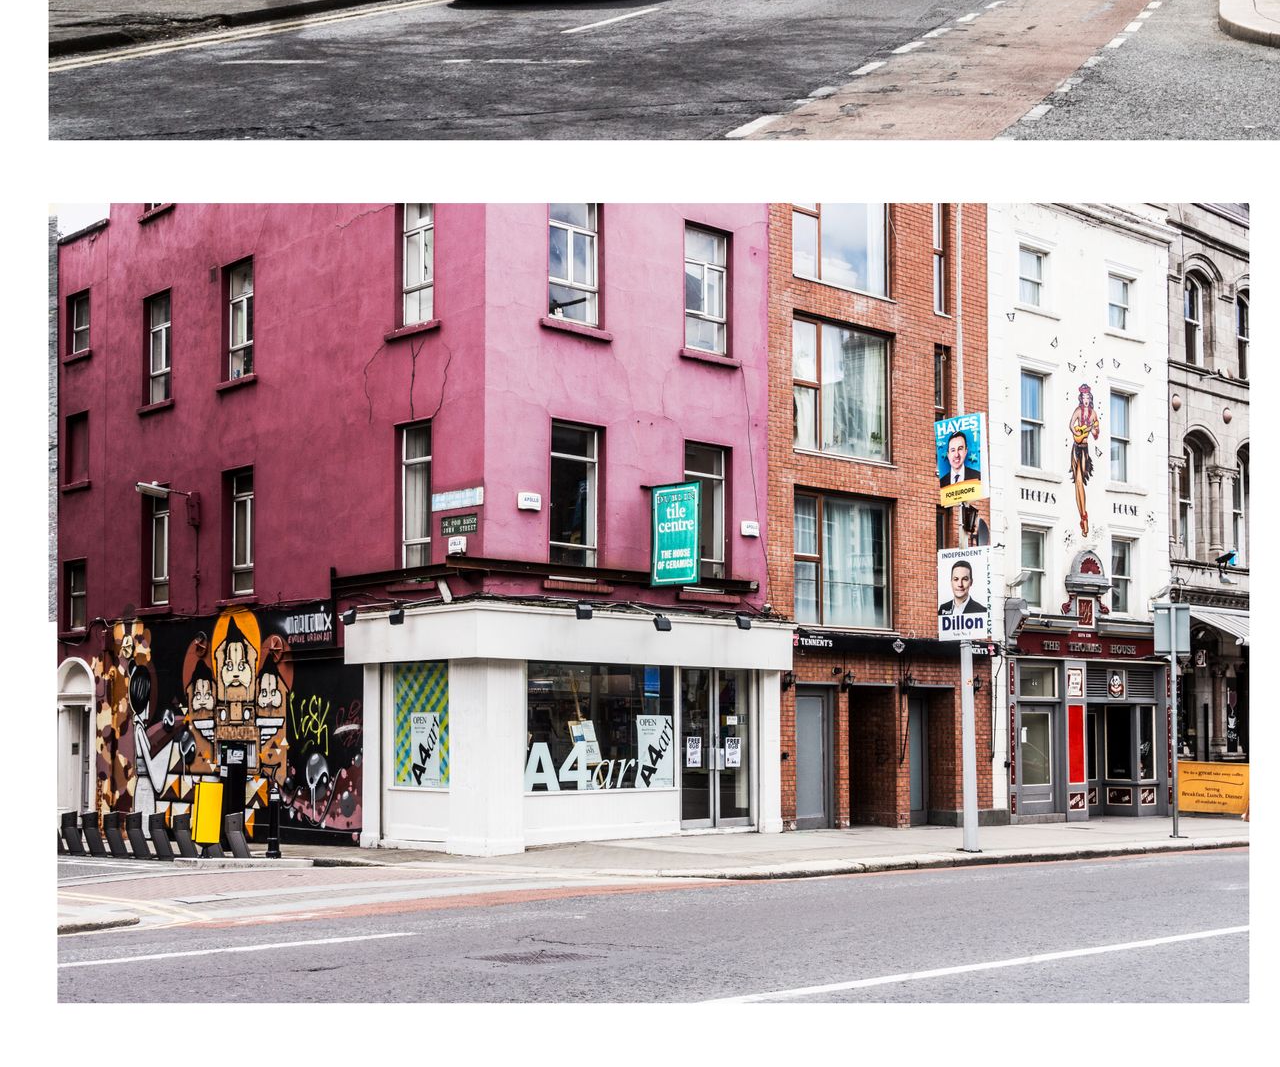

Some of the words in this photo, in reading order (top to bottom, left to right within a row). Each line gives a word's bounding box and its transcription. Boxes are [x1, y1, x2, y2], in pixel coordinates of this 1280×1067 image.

[937, 416, 978, 435] HAYES
[955, 487, 975, 495] EUROPE
[657, 492, 695, 504] DUBLIN
[666, 504, 686, 519] tile
[1113, 503, 1138, 516] HOUSE
[658, 519, 694, 533] centre
[661, 550, 673, 558] THE
[673, 548, 691, 557] HOUSE
[942, 550, 982, 559] INDEPENDENT
[658, 562, 665, 570] OF
[666, 559, 693, 569] CERAMICS
[942, 615, 983, 631] Dillon
[800, 638, 833, 647] TENNENT'S
[1043, 641, 1060, 650] THE
[1068, 642, 1102, 653] THOMAS
[1110, 645, 1136, 654] HOUSE
[412, 715, 439, 785] A4art
[640, 718, 673, 787] A4art
[524, 742, 639, 791] A4ar
